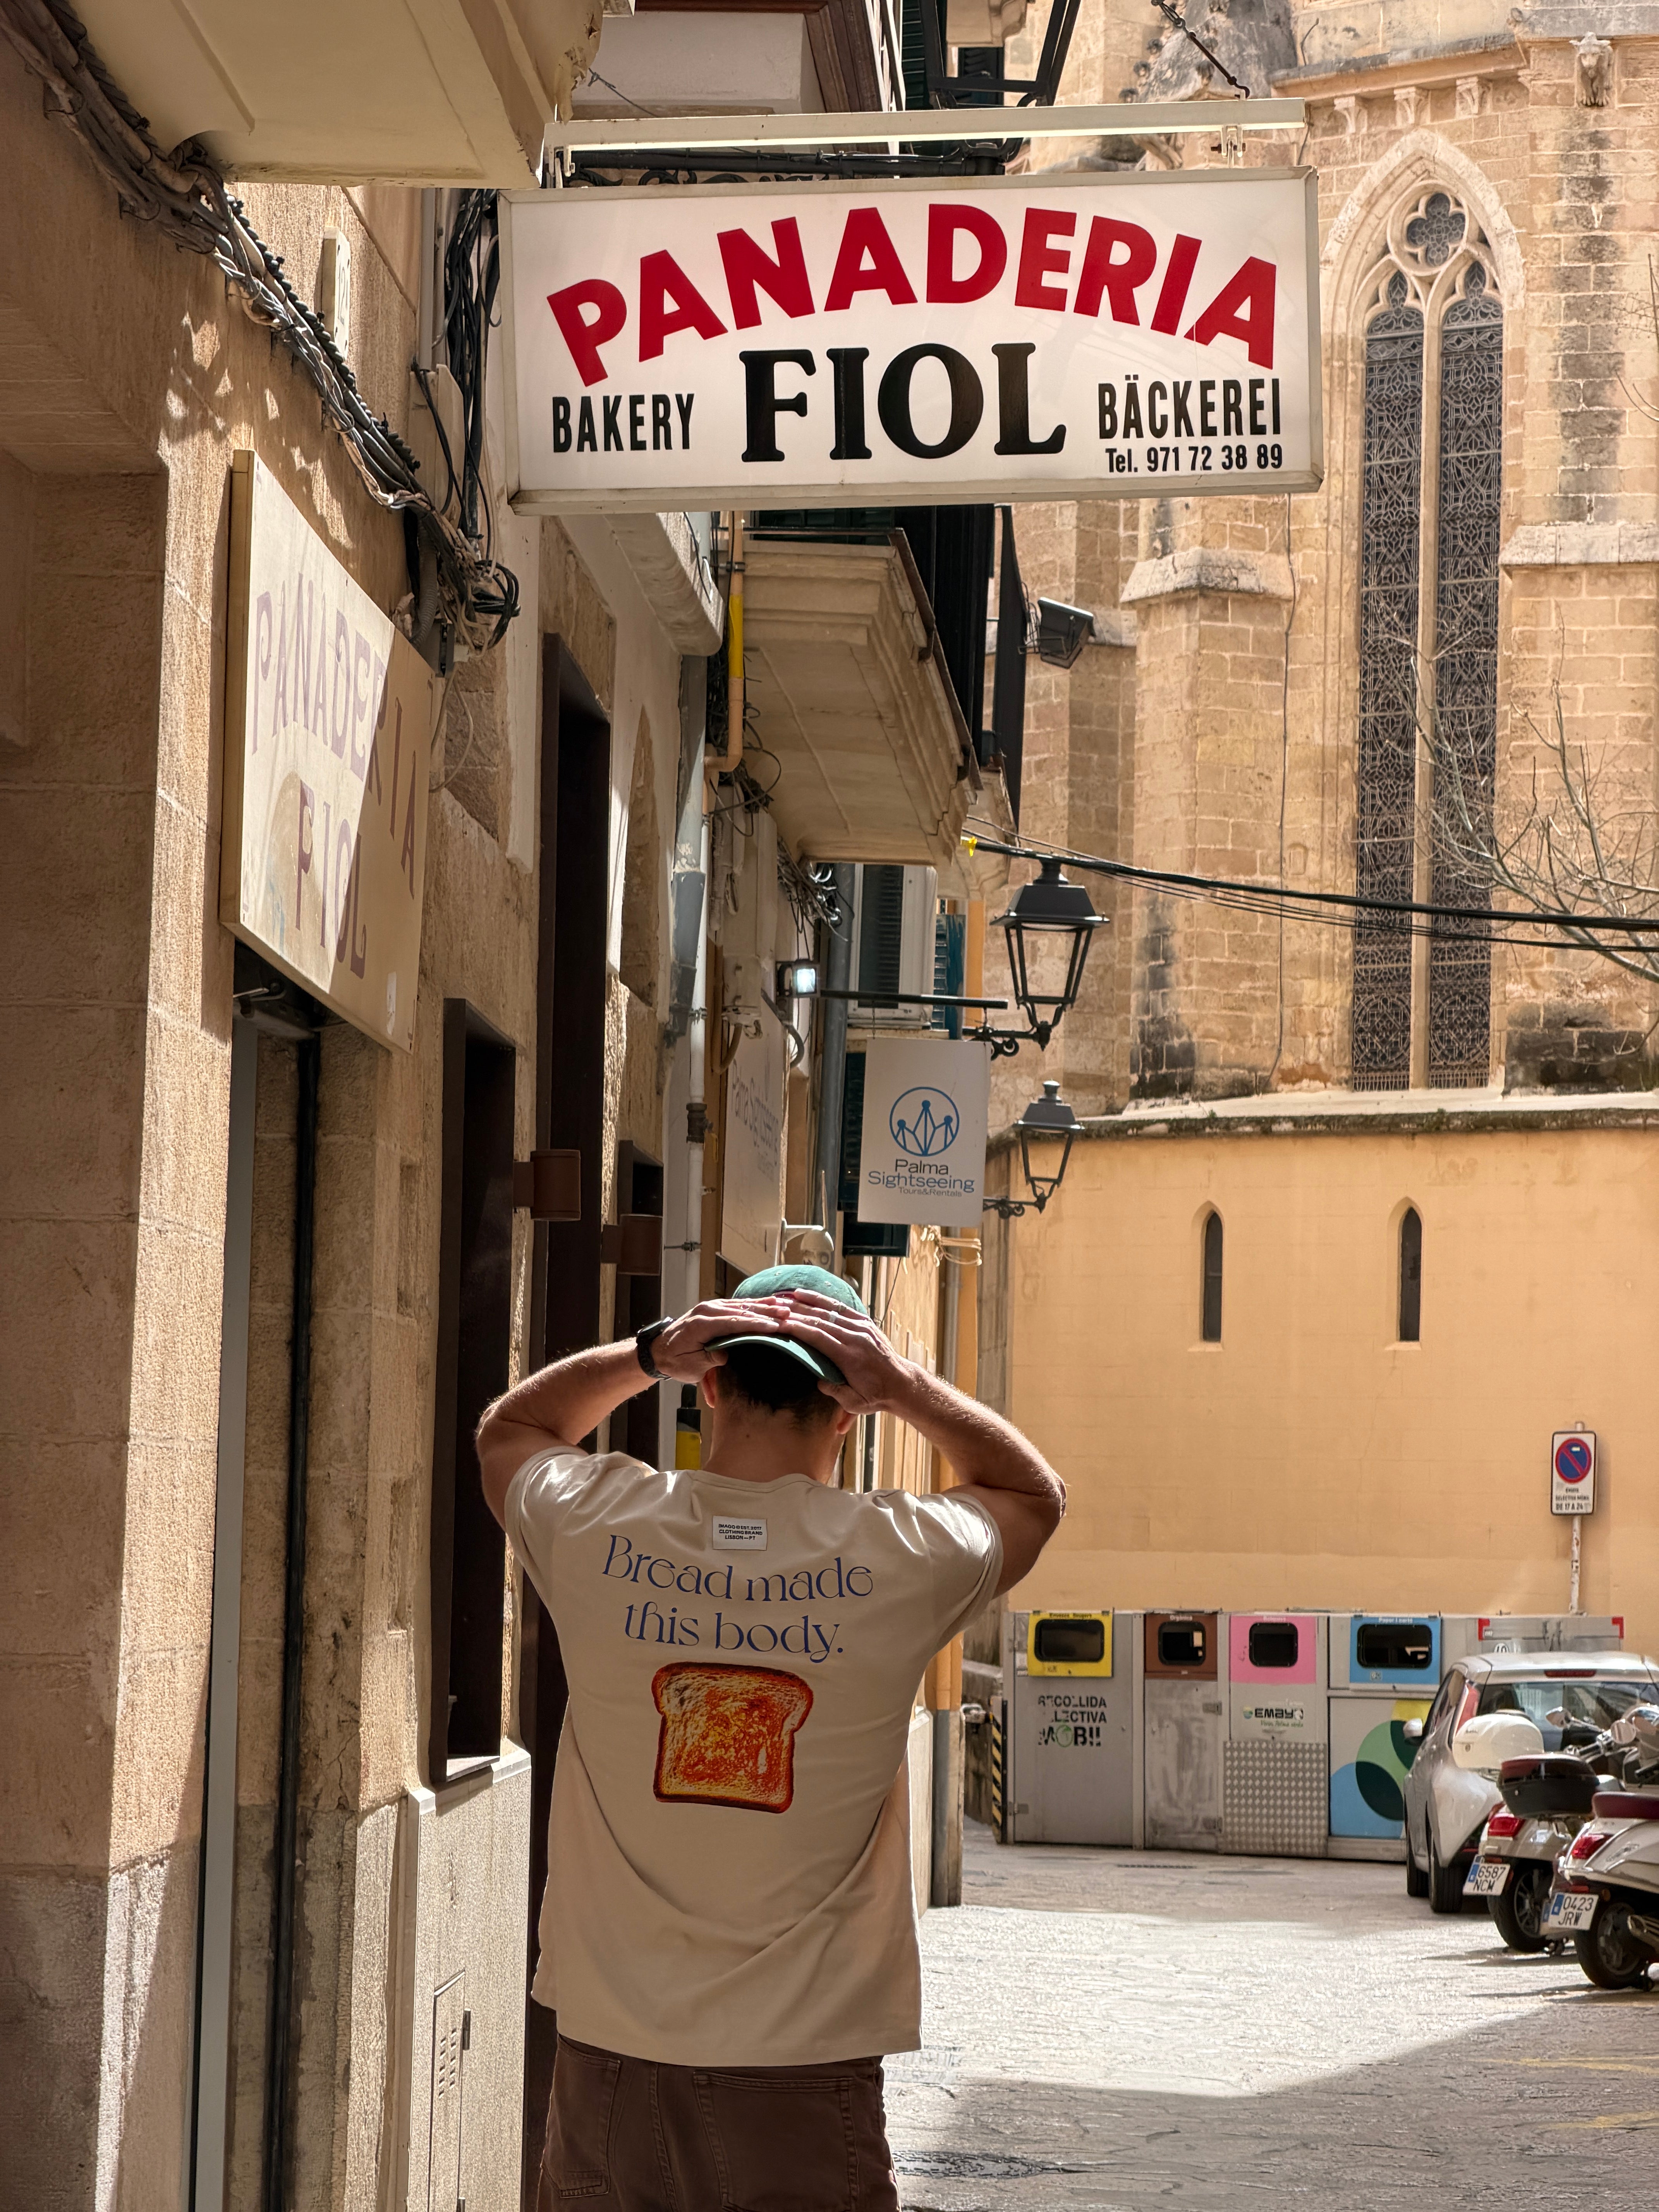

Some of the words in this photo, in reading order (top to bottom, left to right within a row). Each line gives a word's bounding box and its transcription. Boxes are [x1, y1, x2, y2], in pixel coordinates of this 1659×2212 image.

[547, 203, 1276, 387] PANADERIA
[552, 393, 695, 453] BAKERY
[740, 343, 1066, 463] FIOL
[1097, 376, 1281, 440] BÄCKEREI
[1105, 448, 1138, 473] Tel.
[1147, 447, 1180, 472] 971
[1188, 445, 1212, 471] 72
[1221, 445, 1247, 470] 38
[1257, 443, 1283, 469] 89
[252, 572, 416, 900] PANADERIA
[868, 1170, 975, 1193] Sightseeing
[895, 1159, 949, 1175] Palma
[602, 1534, 733, 1600] Bread
[745, 1557, 874, 1602] made
[625, 1601, 700, 1647] this
[715, 1612, 843, 1663] body.
[1473, 1879, 1496, 1892] NCM
[1478, 1865, 1506, 1881] 6587
[1558, 1911, 1582, 1926] JRW
[1563, 1896, 1594, 1911] 0423
